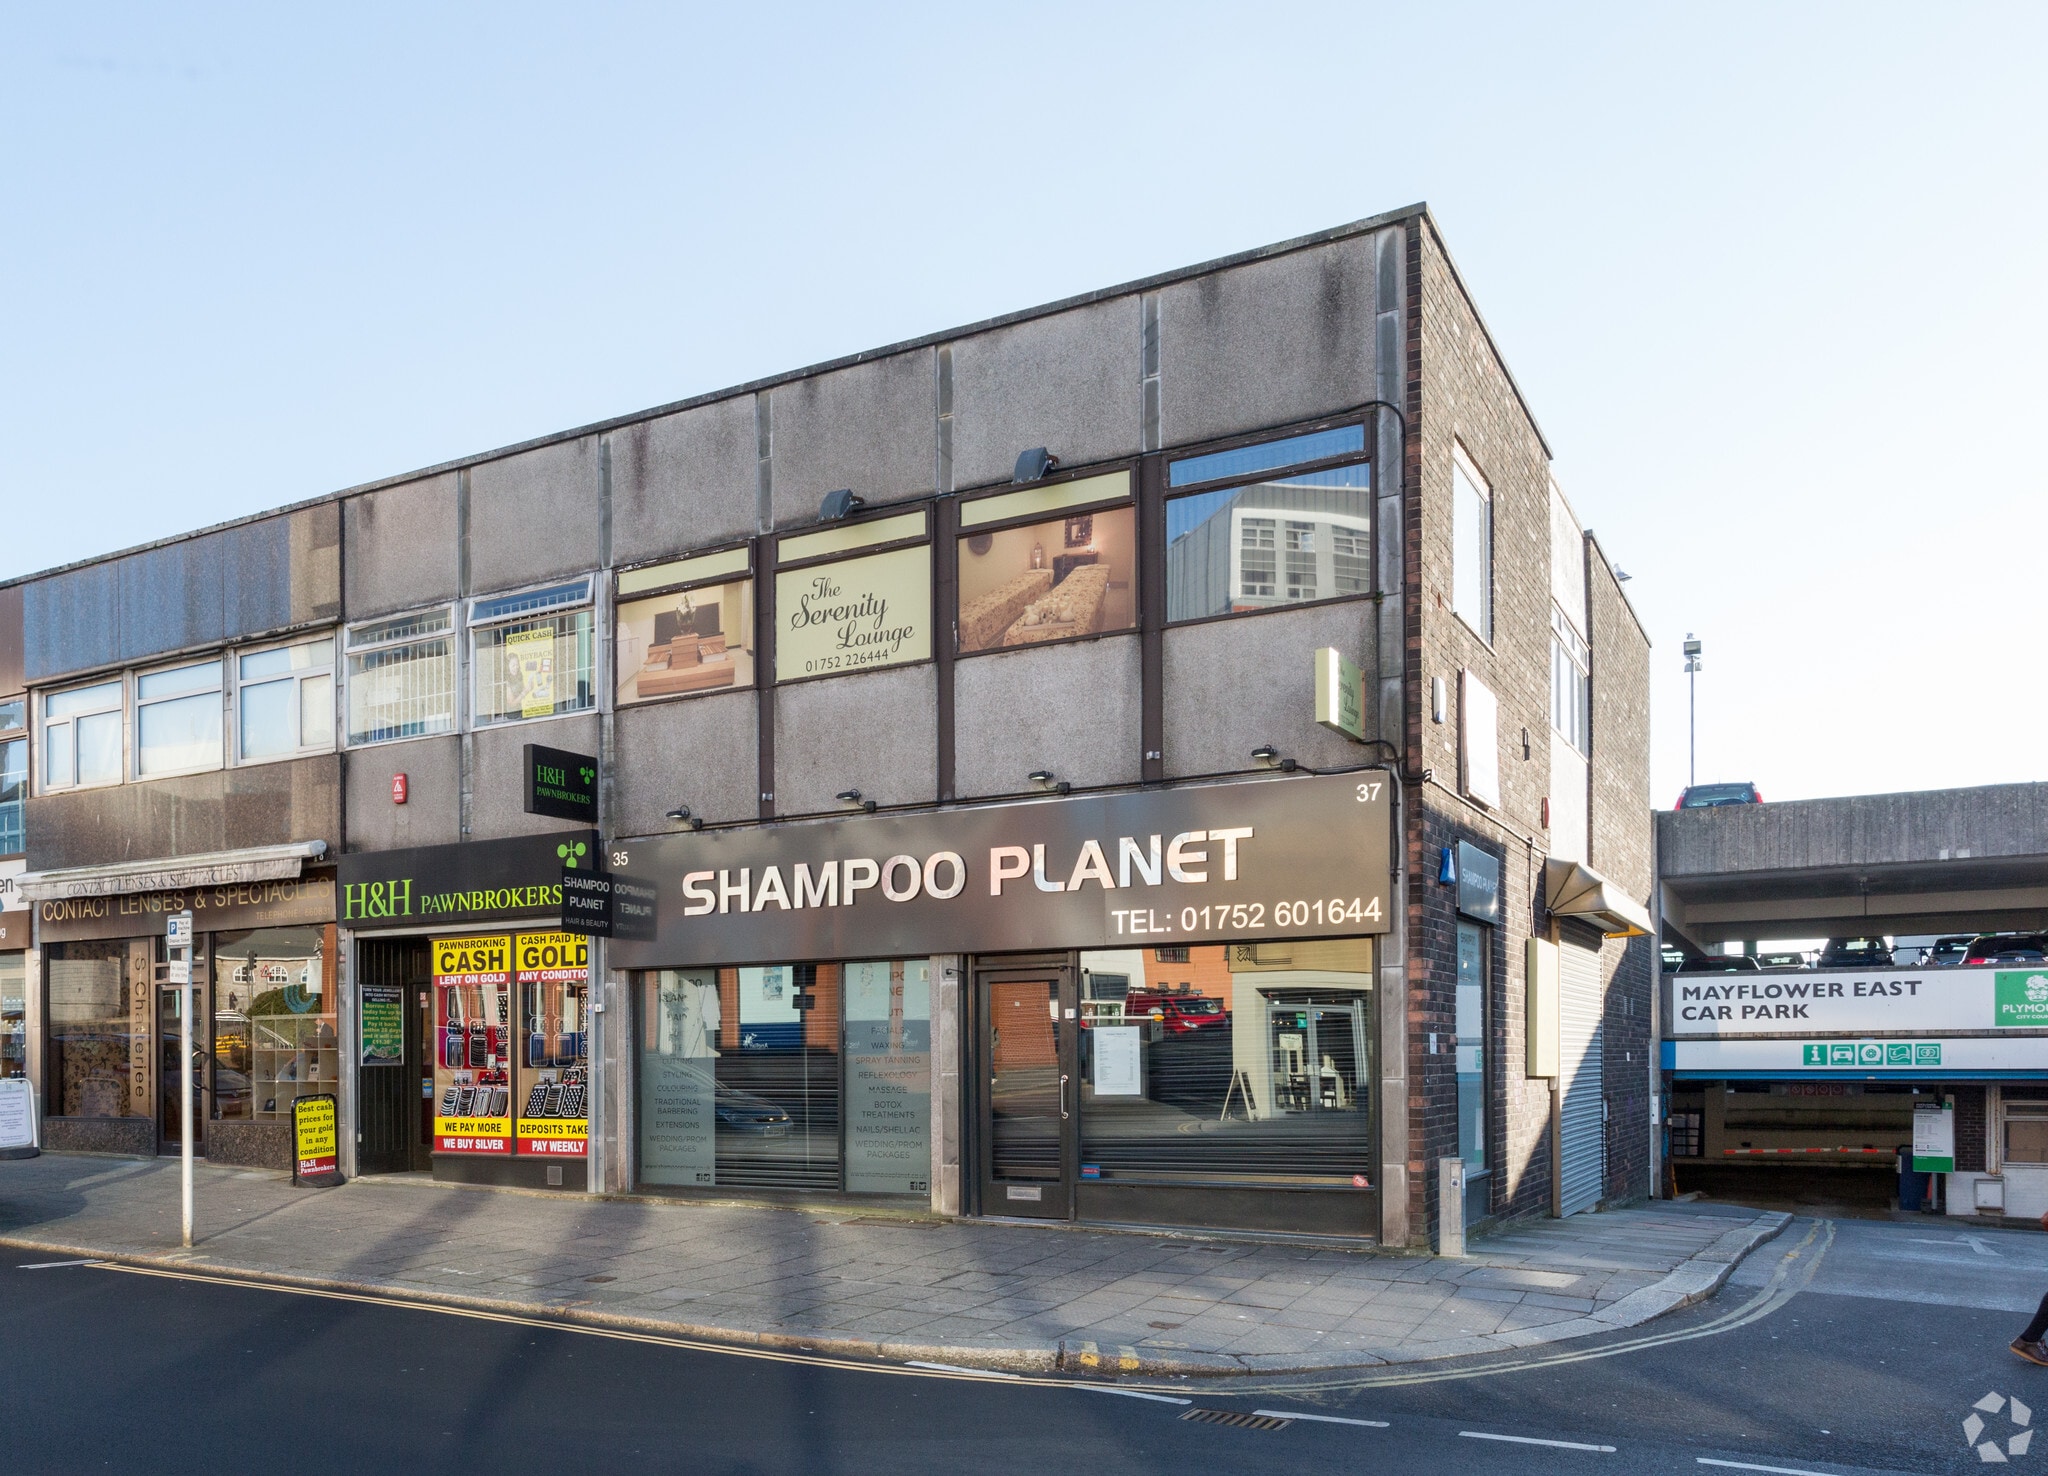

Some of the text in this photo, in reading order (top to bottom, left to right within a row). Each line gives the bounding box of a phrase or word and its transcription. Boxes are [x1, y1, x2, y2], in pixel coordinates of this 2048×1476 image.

[811, 577, 842, 600] The
[791, 592, 888, 631] Serenity
[508, 629, 552, 645] QUICK CASH
[836, 620, 915, 652] Lounge
[521, 649, 552, 661] BUYBACK
[806, 649, 888, 672] 01752 226444
[537, 764, 565, 787] H&H
[537, 786, 590, 804] PAWNBROKERS
[1356, 782, 1382, 802] 37
[612, 851, 628, 866] 35
[682, 827, 1254, 916] SHAMPOO PLANET
[67, 867, 239, 895] CONTACT LENSES & SPECTACLES
[564, 876, 610, 892] SHAMPOO
[43, 877, 330, 921] CONTACT LENSES & SPECTACLES
[343, 878, 563, 920] H&H PAWNBROKERS
[569, 896, 604, 910] PLANET
[256, 907, 331, 920] TELEPHONE 660831
[1111, 896, 1382, 934] TEL: 01752 601644
[565, 917, 580, 925] HAIR
[586, 918, 609, 928] BEAUTY
[439, 938, 506, 950] PAWNBROKING
[520, 933, 587, 945] CASH PAID FO
[440, 949, 504, 973] CASH
[523, 944, 588, 968] GOLD
[439, 973, 506, 985] LENT ON GOLD
[519, 969, 588, 981] ANY CONDITIO
[1682, 980, 1922, 1001] MAYFLOWER EAST
[1682, 1004, 1809, 1020] CAR PARK
[133, 957, 147, 1097] S Chatterjee
[856, 1056, 920, 1064] SPRAY TANNING
[663, 1071, 692, 1079] STYLING
[859, 1071, 917, 1079] REFLEXOLOGY
[656, 1084, 698, 1092] COLOURING
[868, 1086, 908, 1094] MASSAGE
[298, 1103, 333, 1113] Best cash
[654, 1098, 701, 1106] TRADITIONAL
[874, 1101, 902, 1109] BOTOX
[657, 1107, 698, 1115] BARBERING
[862, 1110, 915, 1119] TREATMENTS
[299, 1113, 333, 1126] prices for
[655, 1121, 700, 1129] EXTENSIONS
[299, 1124, 333, 1136] your gold
[445, 1122, 502, 1133] WE PAY MORE
[520, 1124, 588, 1135] DEPOSITS TAKE
[856, 1126, 920, 1134] NAILS/SHELLAC
[315, 1136, 328, 1144] any
[443, 1138, 503, 1150] WE BUY SILVER
[649, 1135, 707, 1143] WEDDING/PROM
[855, 1140, 922, 1149] WEDDING/PROM
[300, 1146, 334, 1156] condition
[532, 1140, 584, 1152] PAY WEEKLY
[866, 1151, 910, 1159] PACKAGES
[300, 1159, 316, 1168] H&H
[301, 1164, 335, 1174] Pawnbrokers
